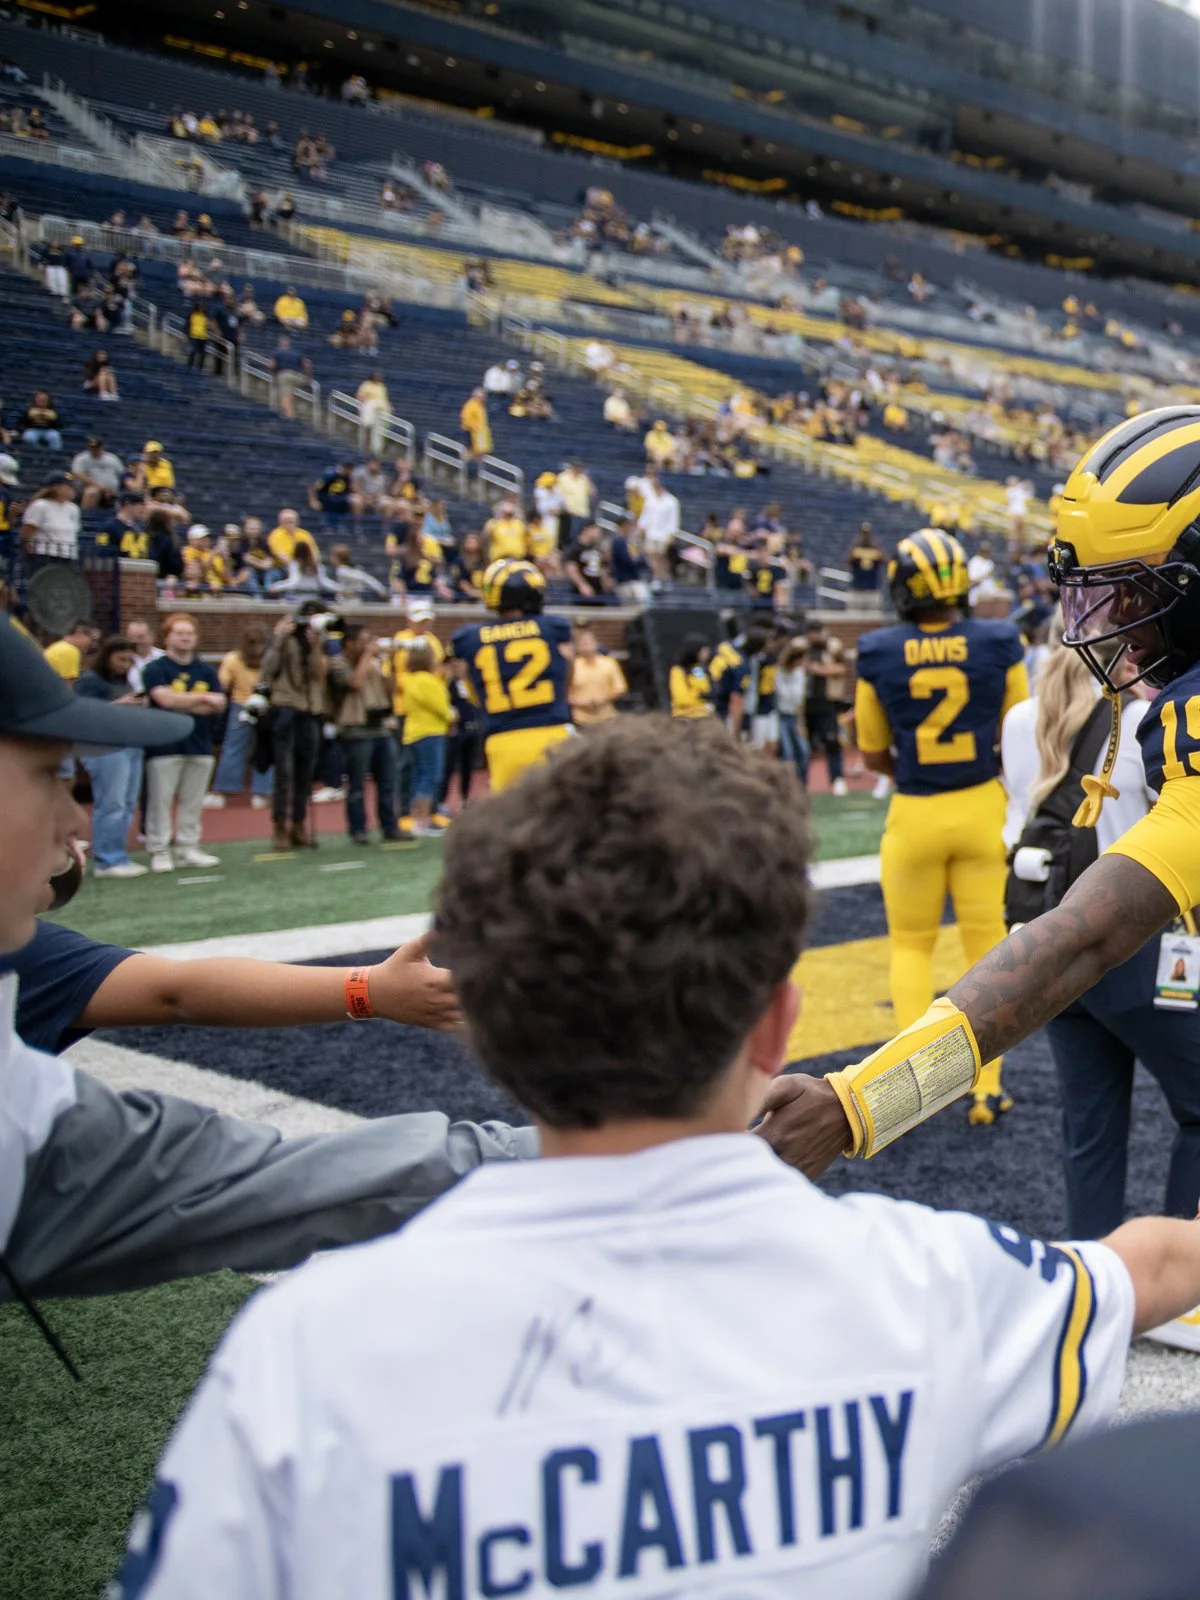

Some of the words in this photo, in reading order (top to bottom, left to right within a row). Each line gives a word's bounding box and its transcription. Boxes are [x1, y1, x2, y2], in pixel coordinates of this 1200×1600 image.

[474, 636, 556, 715] 12
[904, 635, 969, 667] DAVIS
[908, 666, 978, 765] 2
[387, 1389, 916, 1600] McCARTHY
